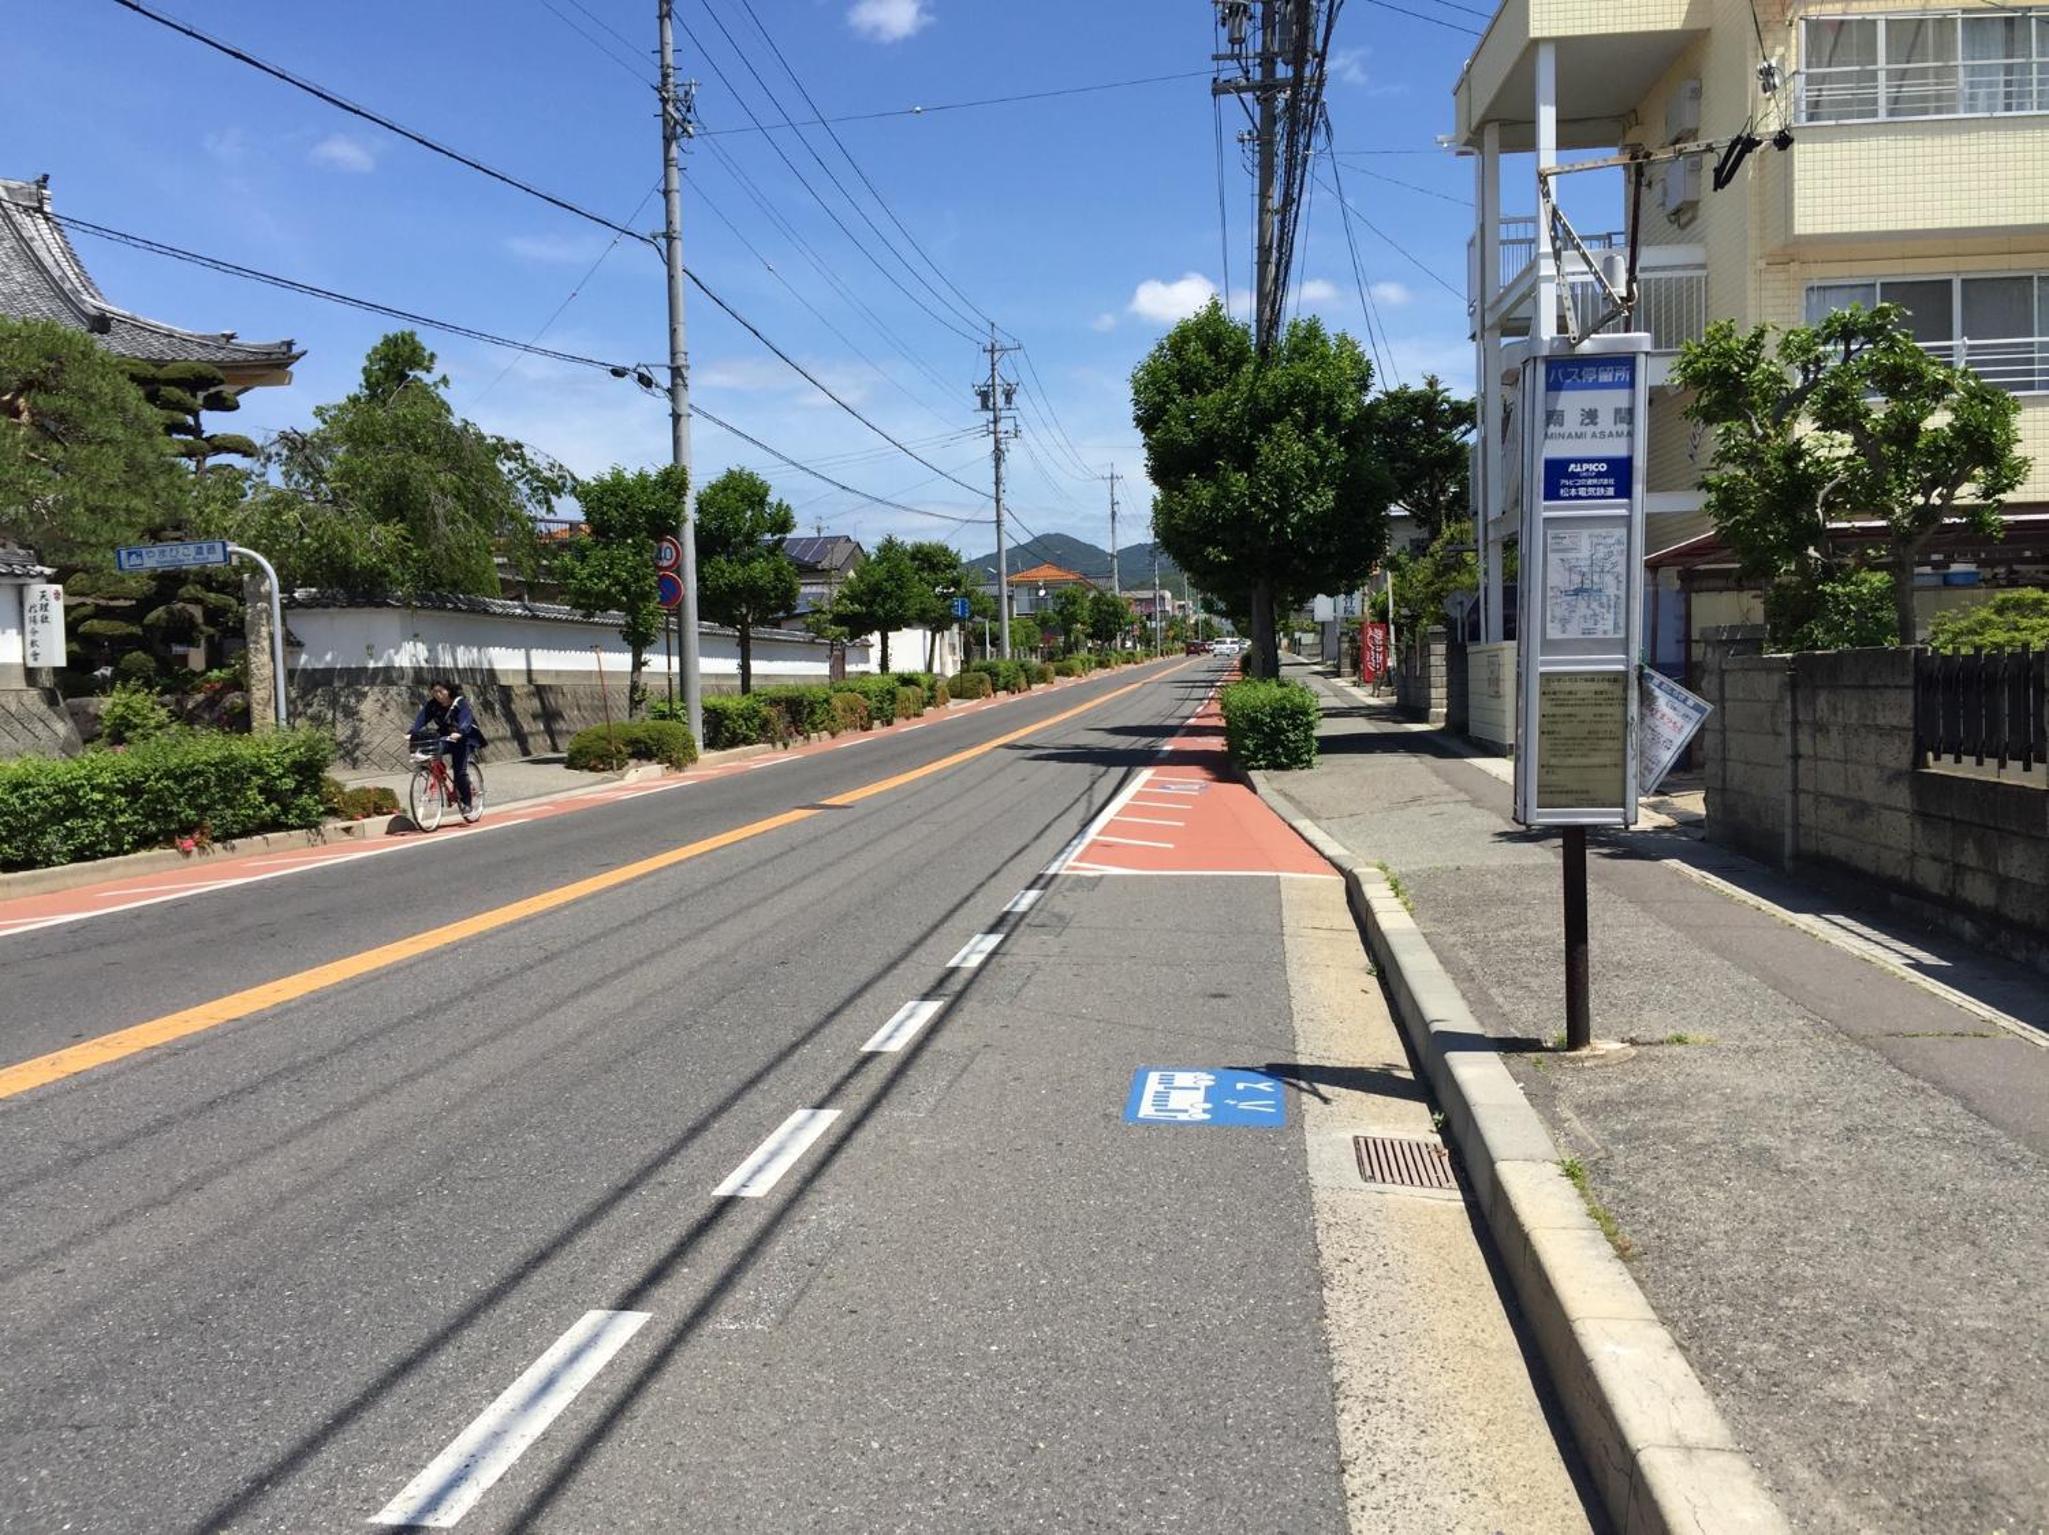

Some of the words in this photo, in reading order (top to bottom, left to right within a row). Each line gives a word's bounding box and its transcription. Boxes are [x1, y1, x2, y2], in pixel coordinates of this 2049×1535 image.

[1549, 365, 1631, 383] バス停留所
[1545, 407, 1633, 427] 南浅間
[1544, 431, 1587, 441] MINAMI
[1591, 430, 1633, 440] ASAMA
[1568, 462, 1608, 473] ALPICO
[1224, 1082, 1277, 1112] バス
